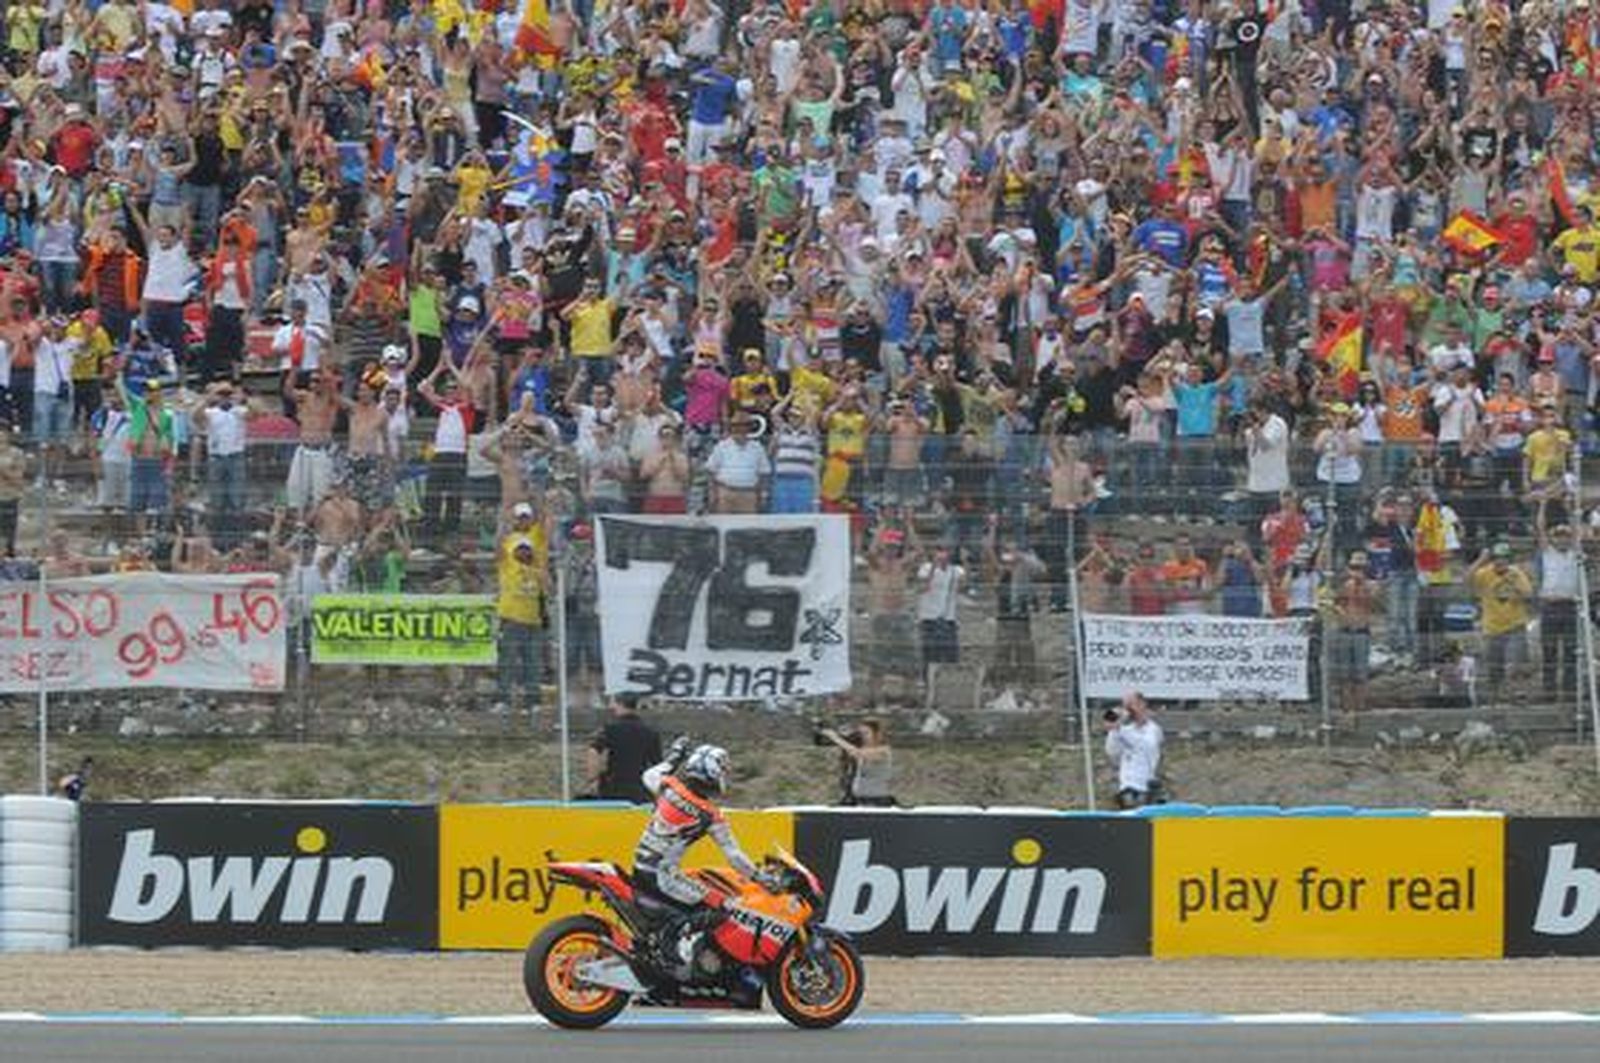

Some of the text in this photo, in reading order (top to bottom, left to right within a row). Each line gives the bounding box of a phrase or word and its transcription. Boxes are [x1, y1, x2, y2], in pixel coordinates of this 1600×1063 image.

[118, 612, 187, 677] 99
[208, 579, 280, 643] 46
[599, 517, 817, 652] 76
[626, 648, 813, 698] Bernat
[107, 827, 395, 924] bwin
[457, 856, 556, 914] play
[825, 838, 1107, 934] bwin
[1178, 867, 1476, 923] play for real
